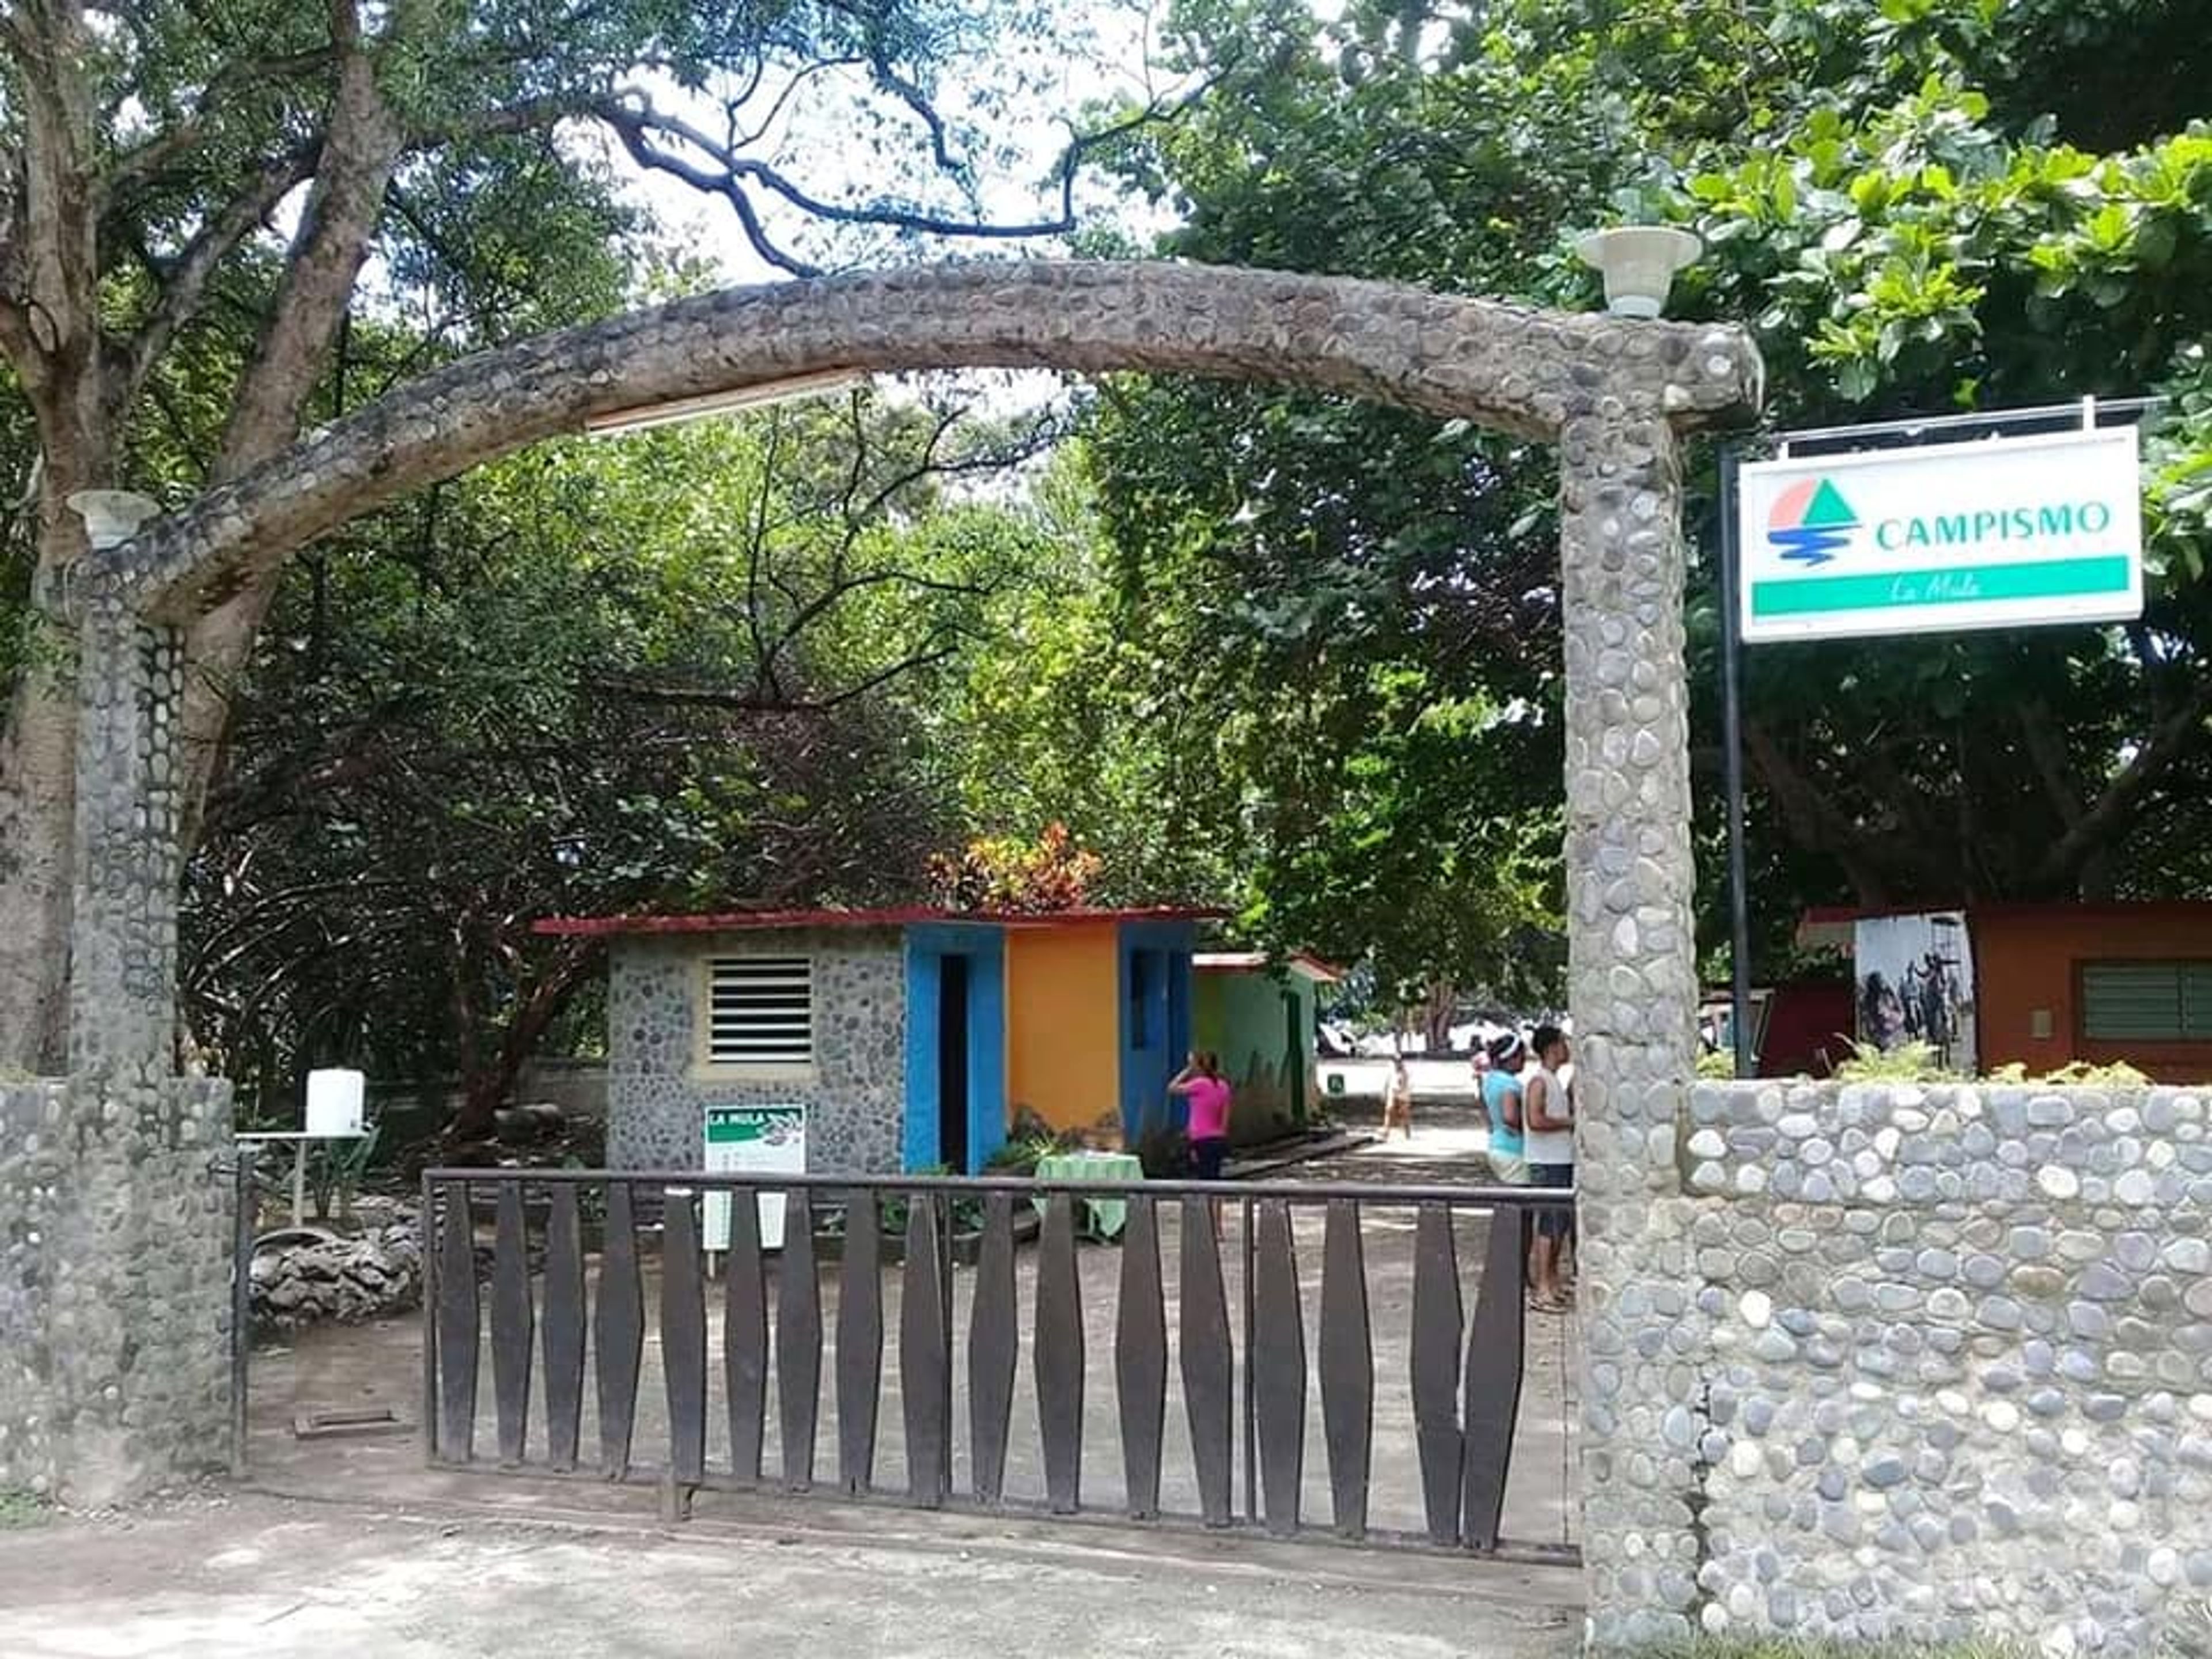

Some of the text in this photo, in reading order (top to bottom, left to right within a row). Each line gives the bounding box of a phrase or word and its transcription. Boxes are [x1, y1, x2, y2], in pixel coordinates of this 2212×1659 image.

[1876, 501, 2110, 551] CAMPISMO
[1891, 575, 1916, 601] La
[709, 1114, 725, 1125] LA
